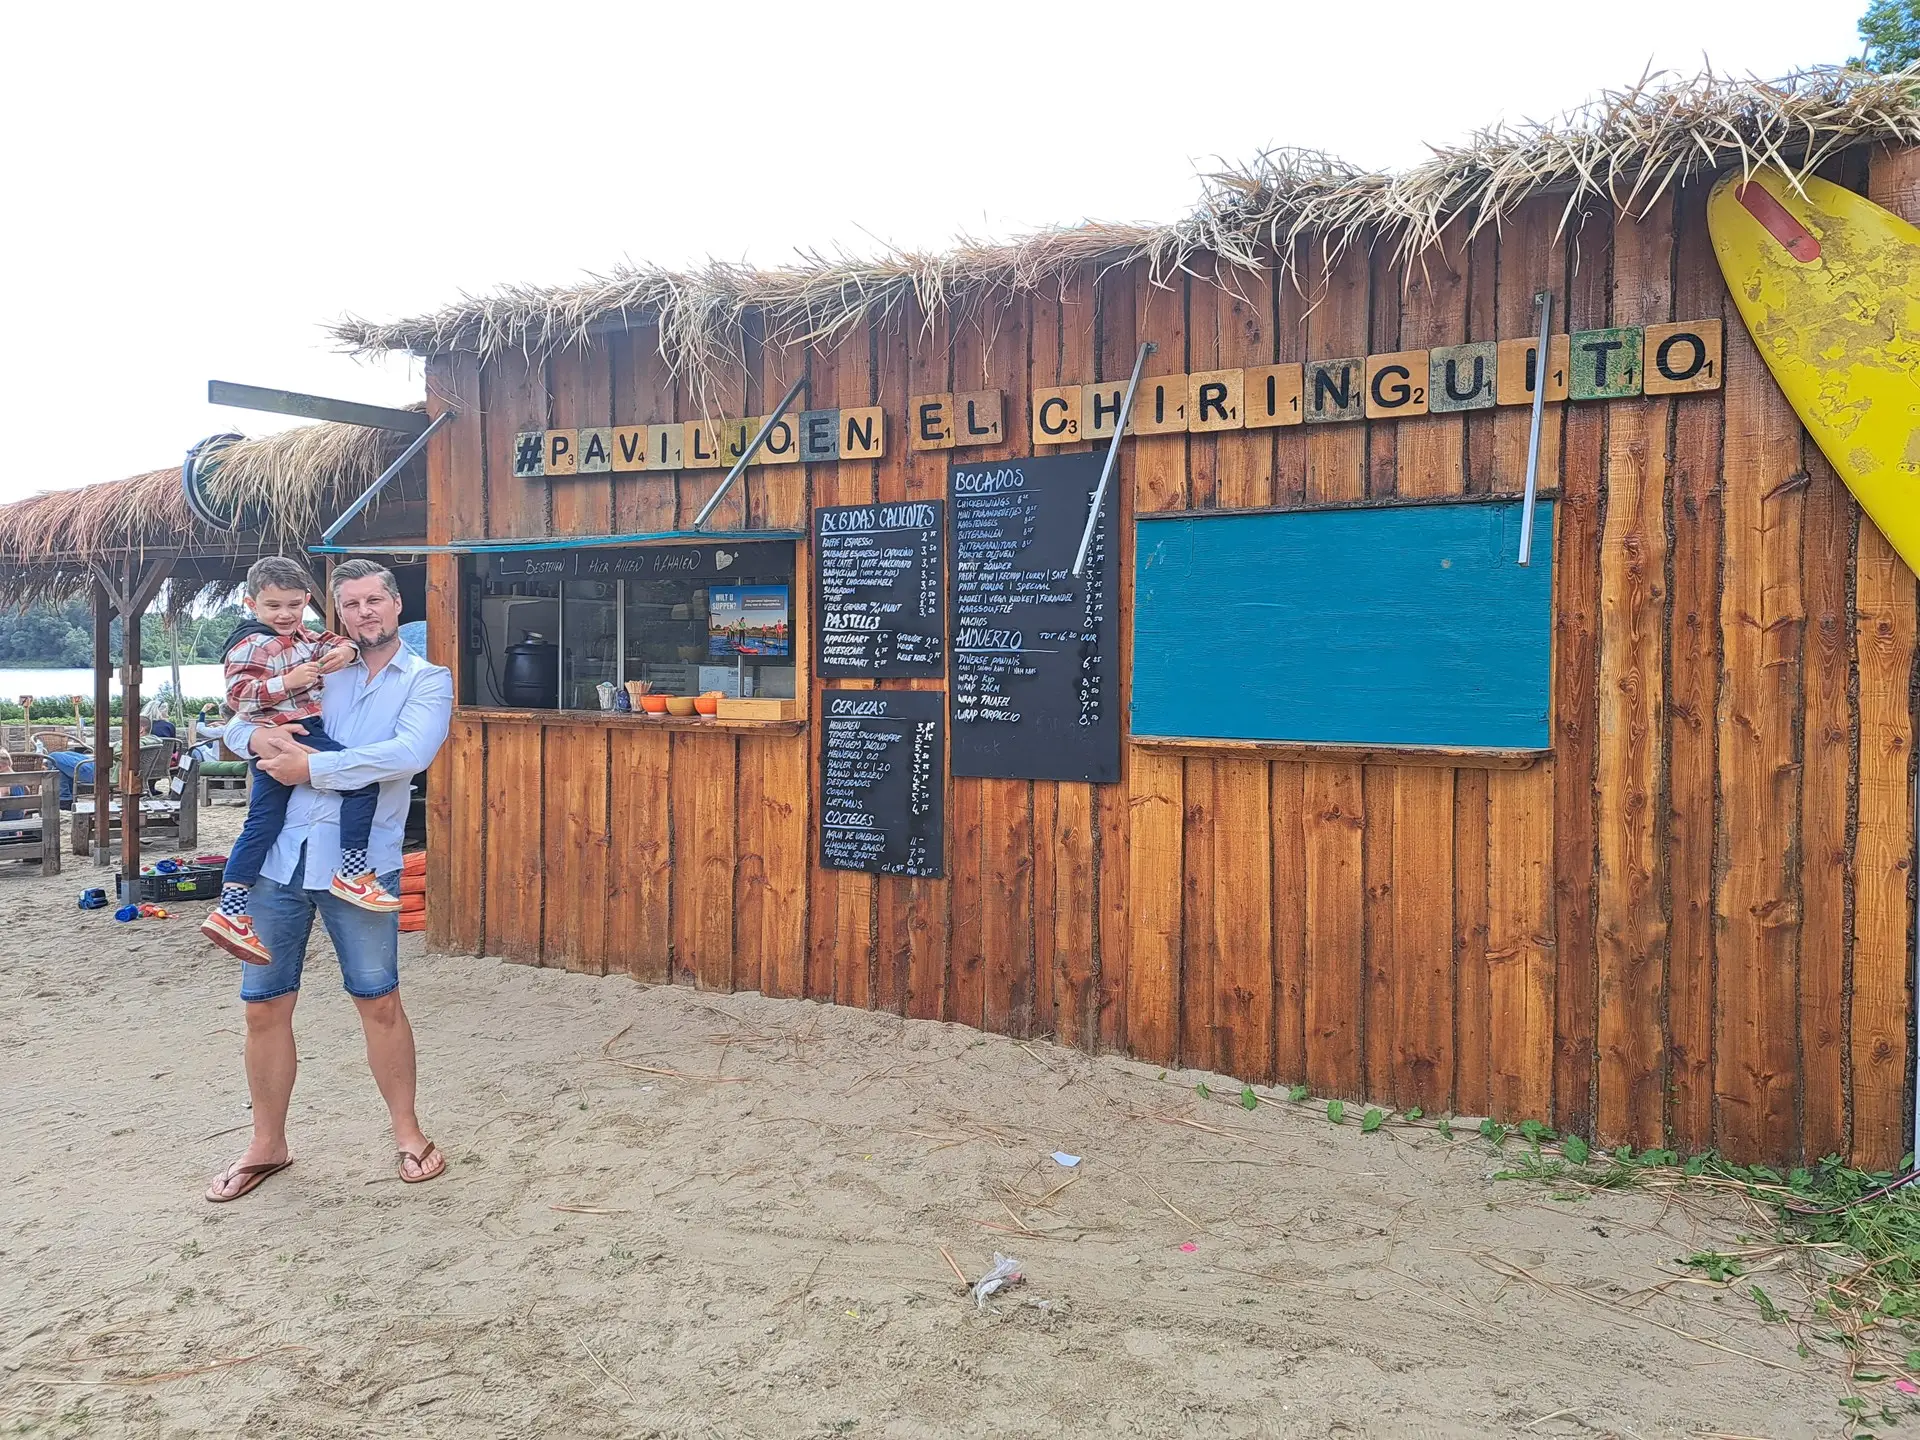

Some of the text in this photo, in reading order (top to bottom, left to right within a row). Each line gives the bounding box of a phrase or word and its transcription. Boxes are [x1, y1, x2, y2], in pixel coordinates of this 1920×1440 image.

[920, 401, 989, 440] EL
[1039, 333, 1708, 435] CHIRINGUITO
[955, 469, 1025, 492] BOCADOS
[958, 551, 983, 559] PORTIE
[958, 562, 980, 571] PATAT
[958, 582, 978, 591] PATAT
[715, 593, 734, 602] WILT U
[712, 601, 738, 610] SUPPEN?
[824, 612, 880, 630] PASTELES
[960, 617, 987, 626] NACHOS
[958, 654, 988, 664] DIVERSE
[958, 674, 978, 684] WRAP
[958, 682, 976, 693] WRAP
[958, 694, 977, 706] WRAP
[832, 699, 887, 715] CERVEZAS
[958, 709, 978, 722] WRAP
[827, 777, 872, 787] DESPERADOS
[824, 810, 874, 828] COCTELES
